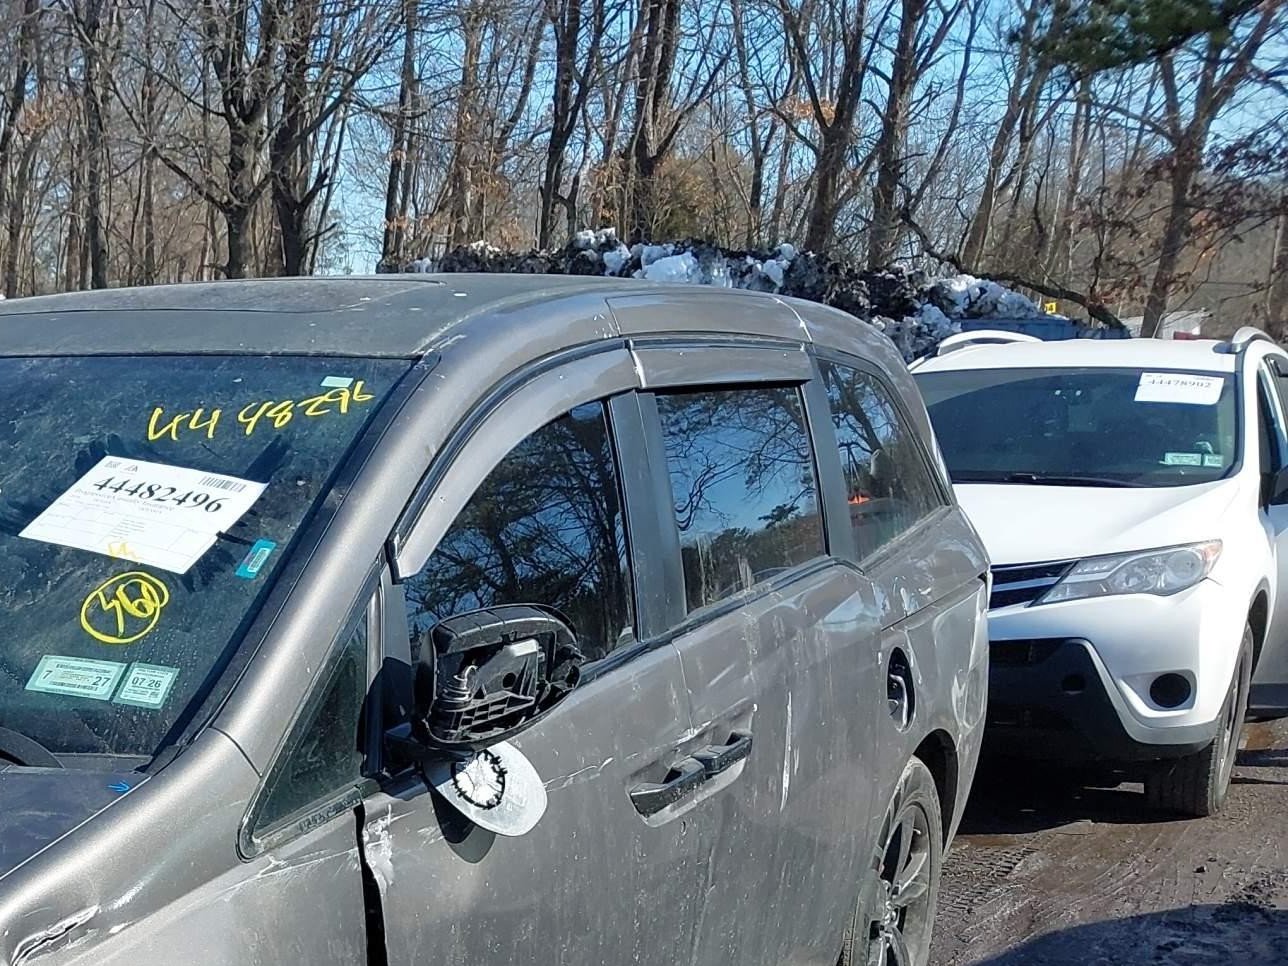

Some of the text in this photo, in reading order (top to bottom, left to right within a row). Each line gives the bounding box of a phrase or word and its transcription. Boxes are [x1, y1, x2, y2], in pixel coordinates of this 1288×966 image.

[93, 475, 233, 513] 44482496
[41, 669, 54, 681] 7
[91, 675, 112, 688] 27
